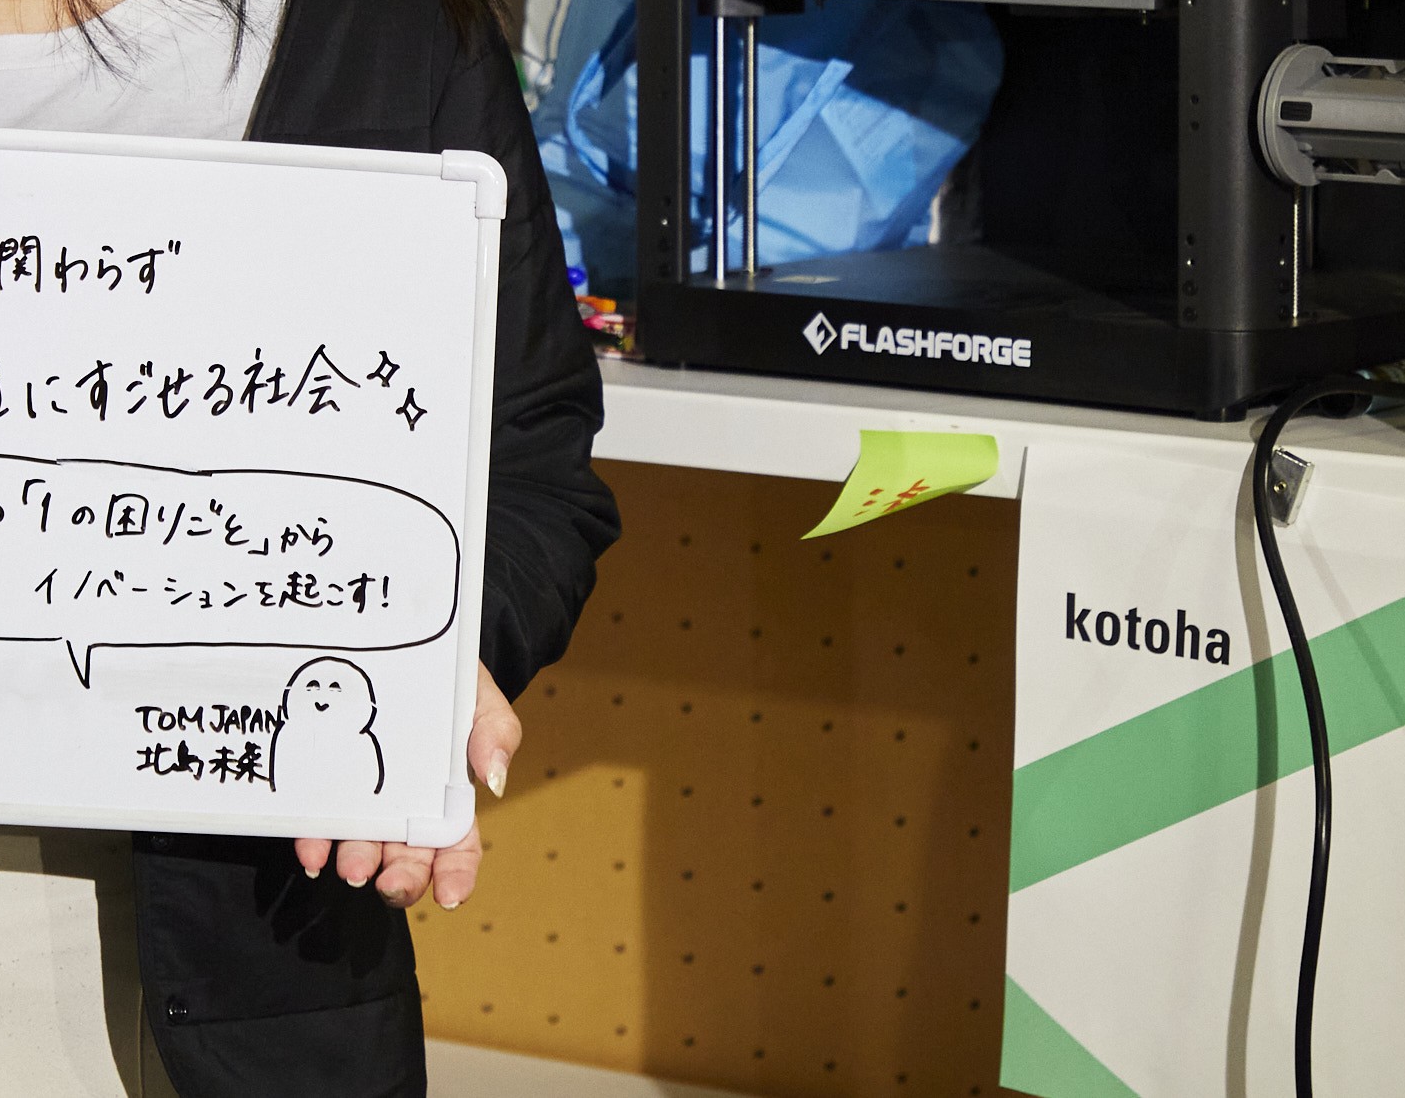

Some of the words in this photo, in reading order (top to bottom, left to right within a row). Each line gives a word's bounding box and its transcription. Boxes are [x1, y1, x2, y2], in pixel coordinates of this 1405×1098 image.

[840, 322, 1032, 368] FLASHFORGE
[1066, 592, 1231, 666] kotoha
[134, 705, 203, 734] TOM
[208, 704, 284, 735] JAPAN
